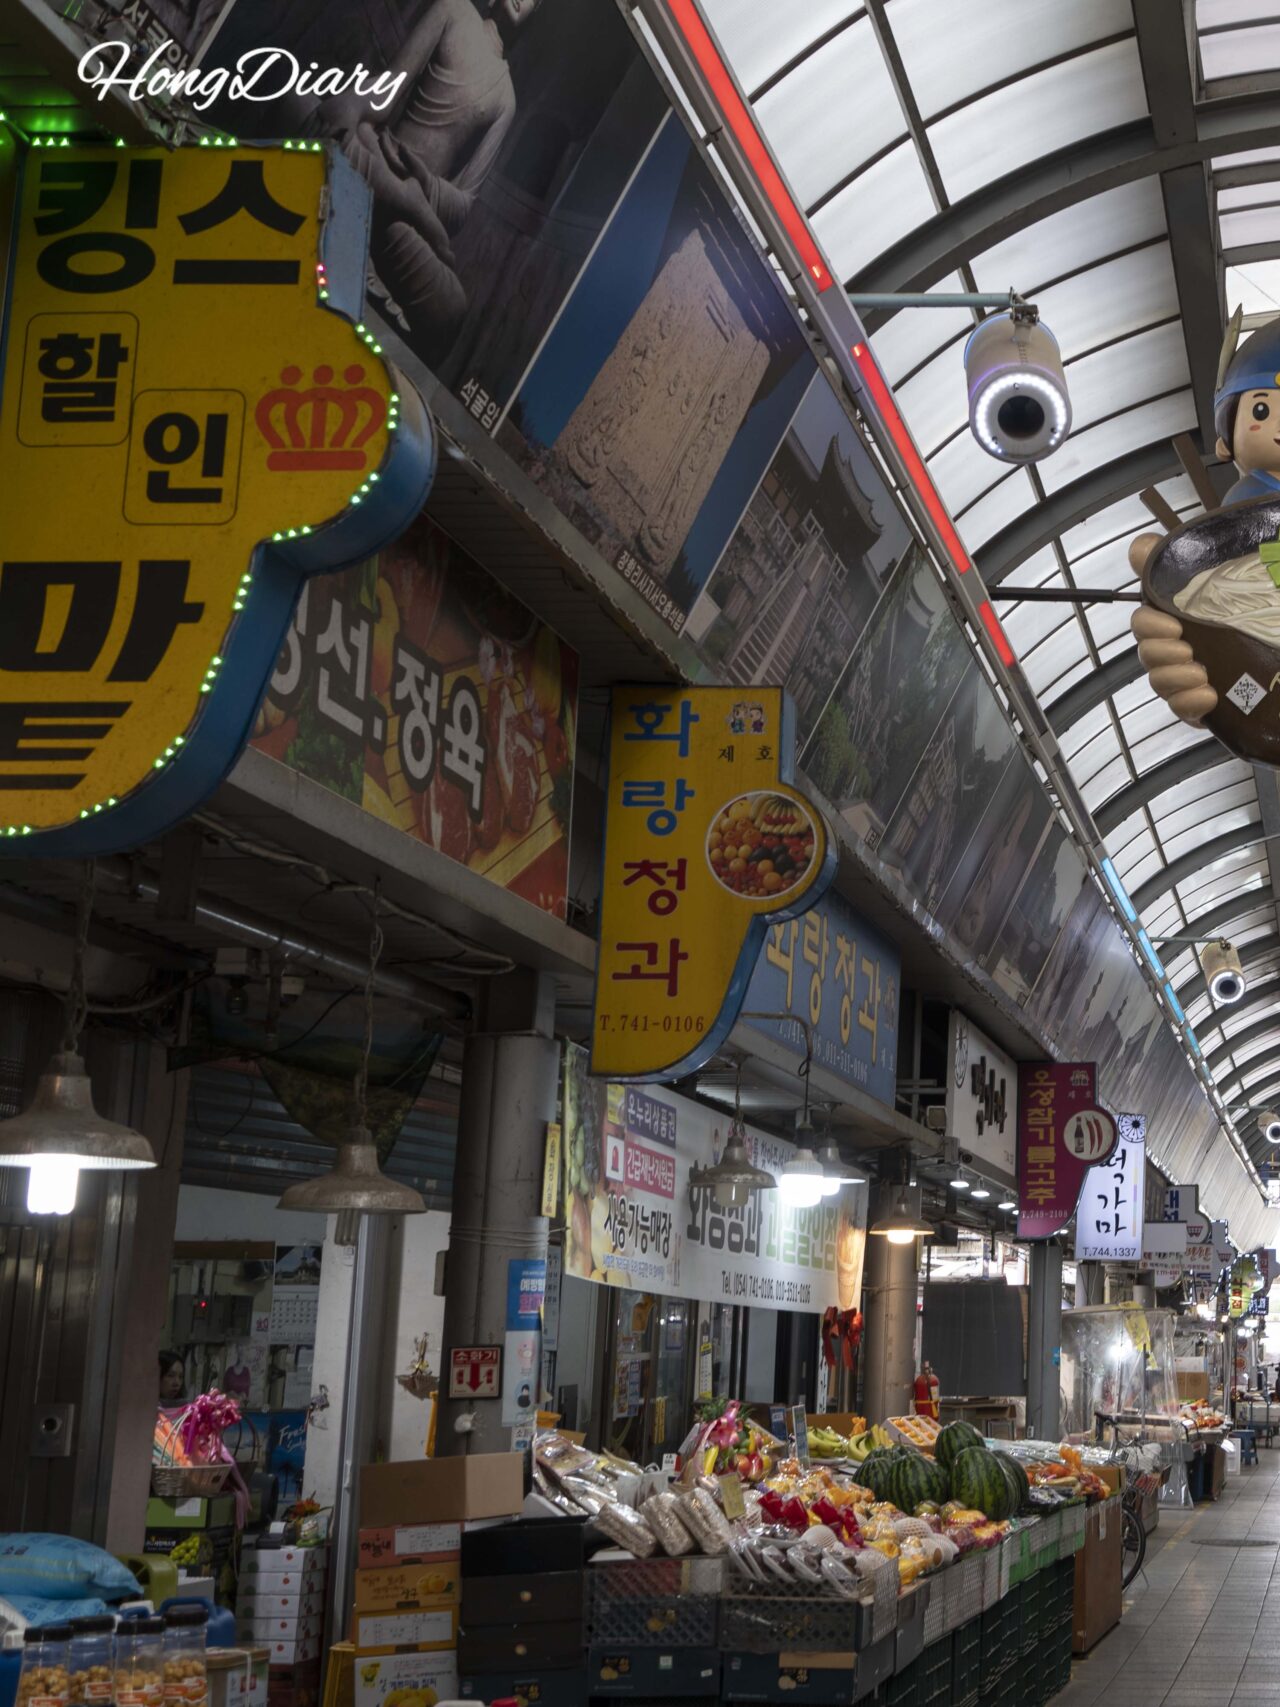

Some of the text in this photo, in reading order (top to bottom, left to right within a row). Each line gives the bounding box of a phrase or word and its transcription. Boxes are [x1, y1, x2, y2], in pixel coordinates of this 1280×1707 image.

[33, 159, 307, 294] 킹스
[37, 332, 229, 503] 할인
[460, 377, 503, 431] 석굴암
[611, 699, 700, 998] 화랑청과
[599, 1014, 705, 1034] T.741-0106
[627, 1093, 676, 1142] 온누리상품권
[626, 1148, 675, 1193] 긴급재난지원금
[1082, 1247, 1137, 1258] T.744.1337
[454, 1350, 497, 1362] 소화기
